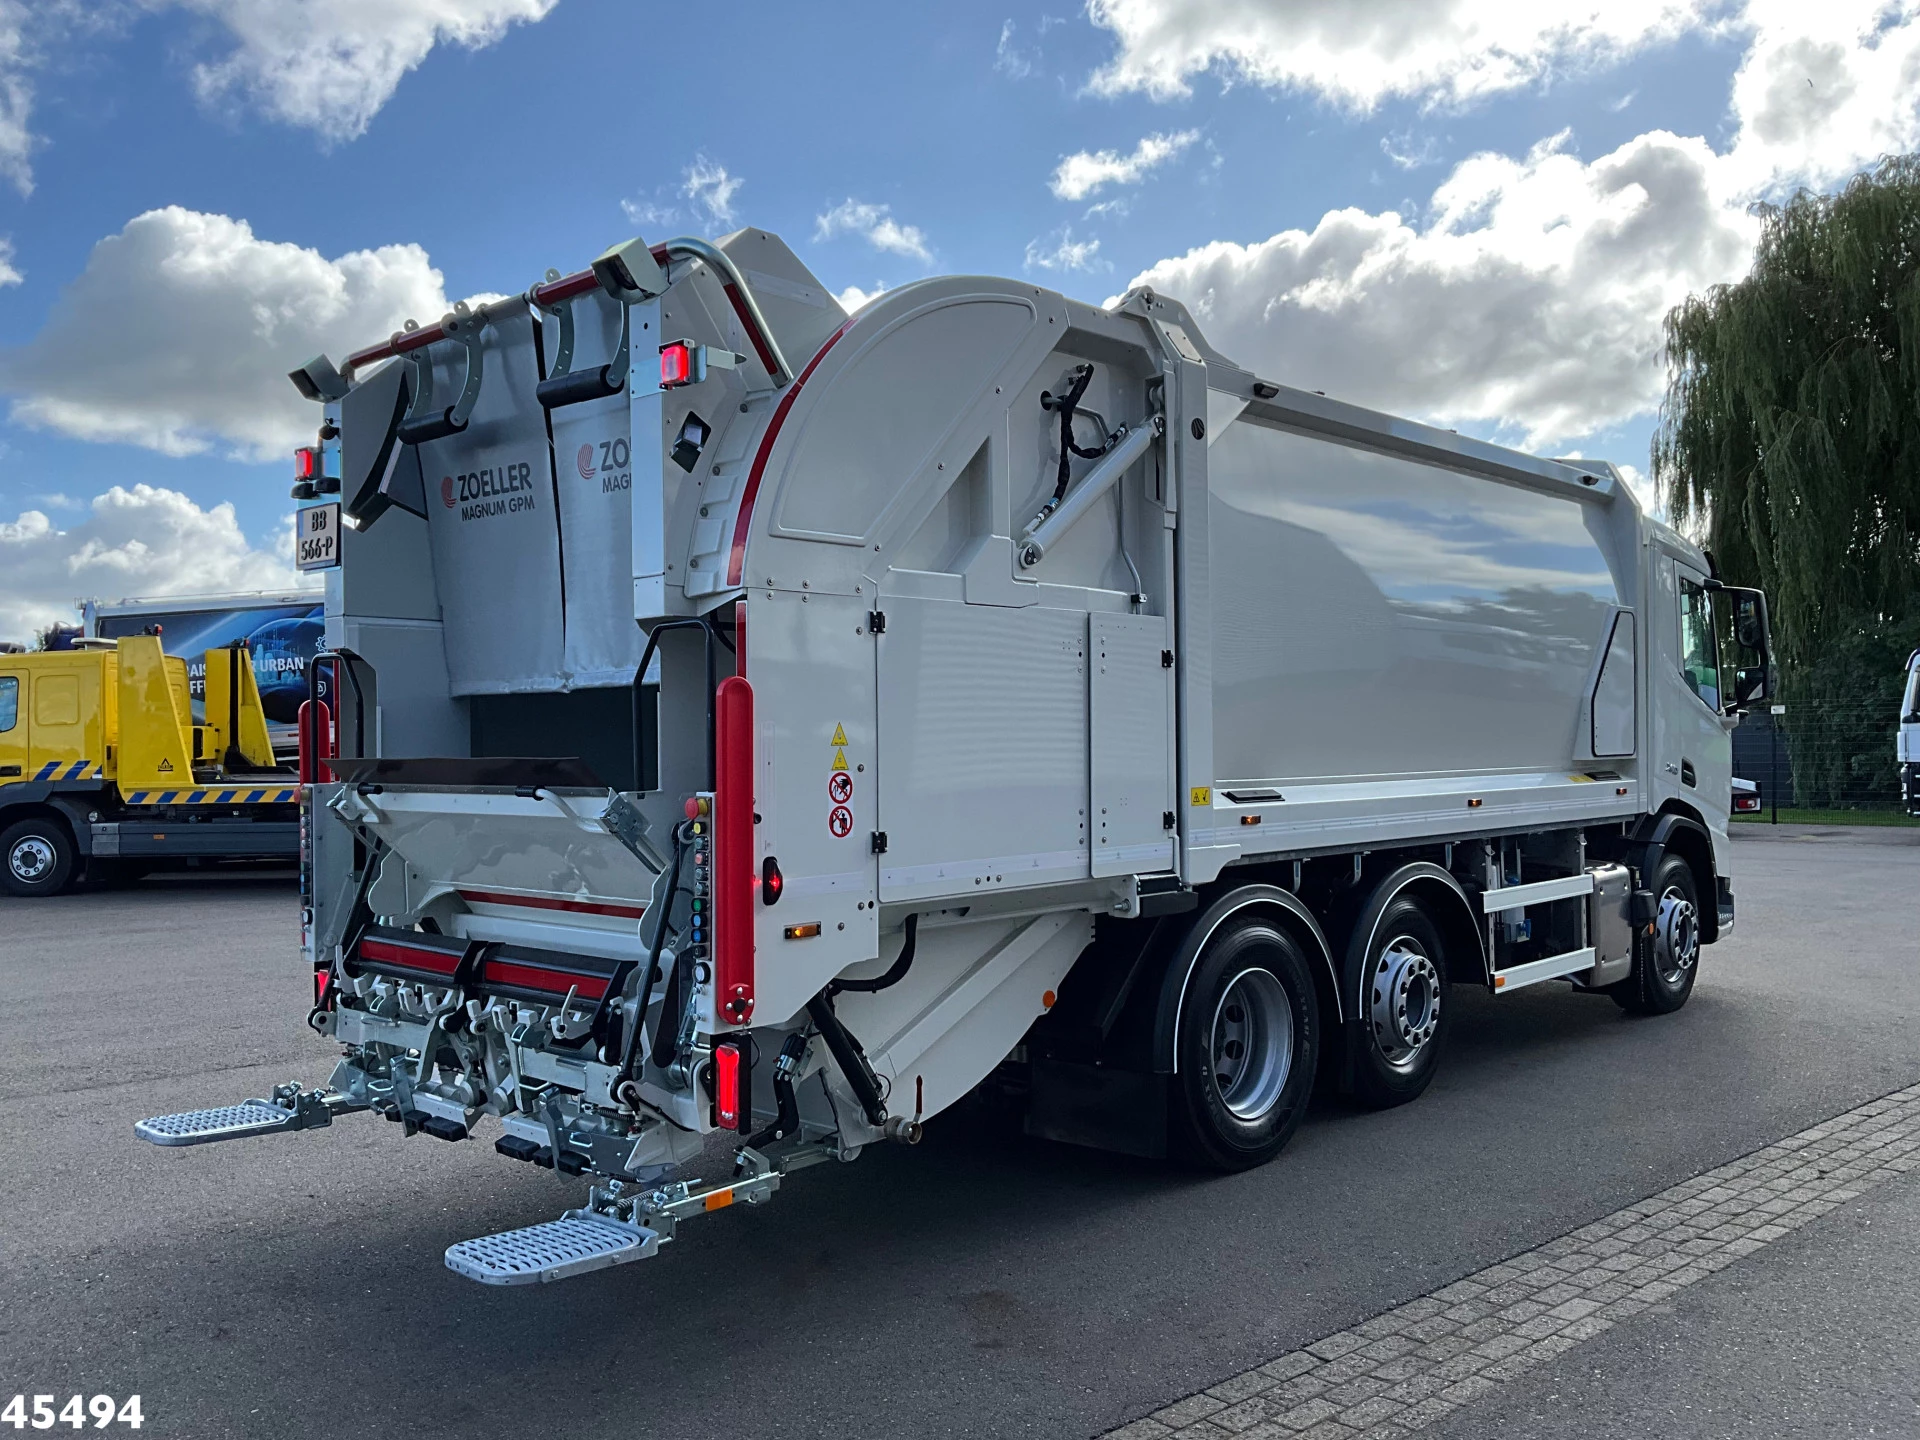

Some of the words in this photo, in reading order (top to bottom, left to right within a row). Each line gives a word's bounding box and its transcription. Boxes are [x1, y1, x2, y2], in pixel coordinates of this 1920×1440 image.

[600, 436, 632, 471] ZO
[457, 462, 533, 502] ZOELLER
[603, 473, 632, 493] MAG
[461, 499, 507, 522] MAGNUM
[509, 495, 536, 513] GPM
[301, 535, 333, 561] 566-P
[260, 656, 304, 672] URBAN
